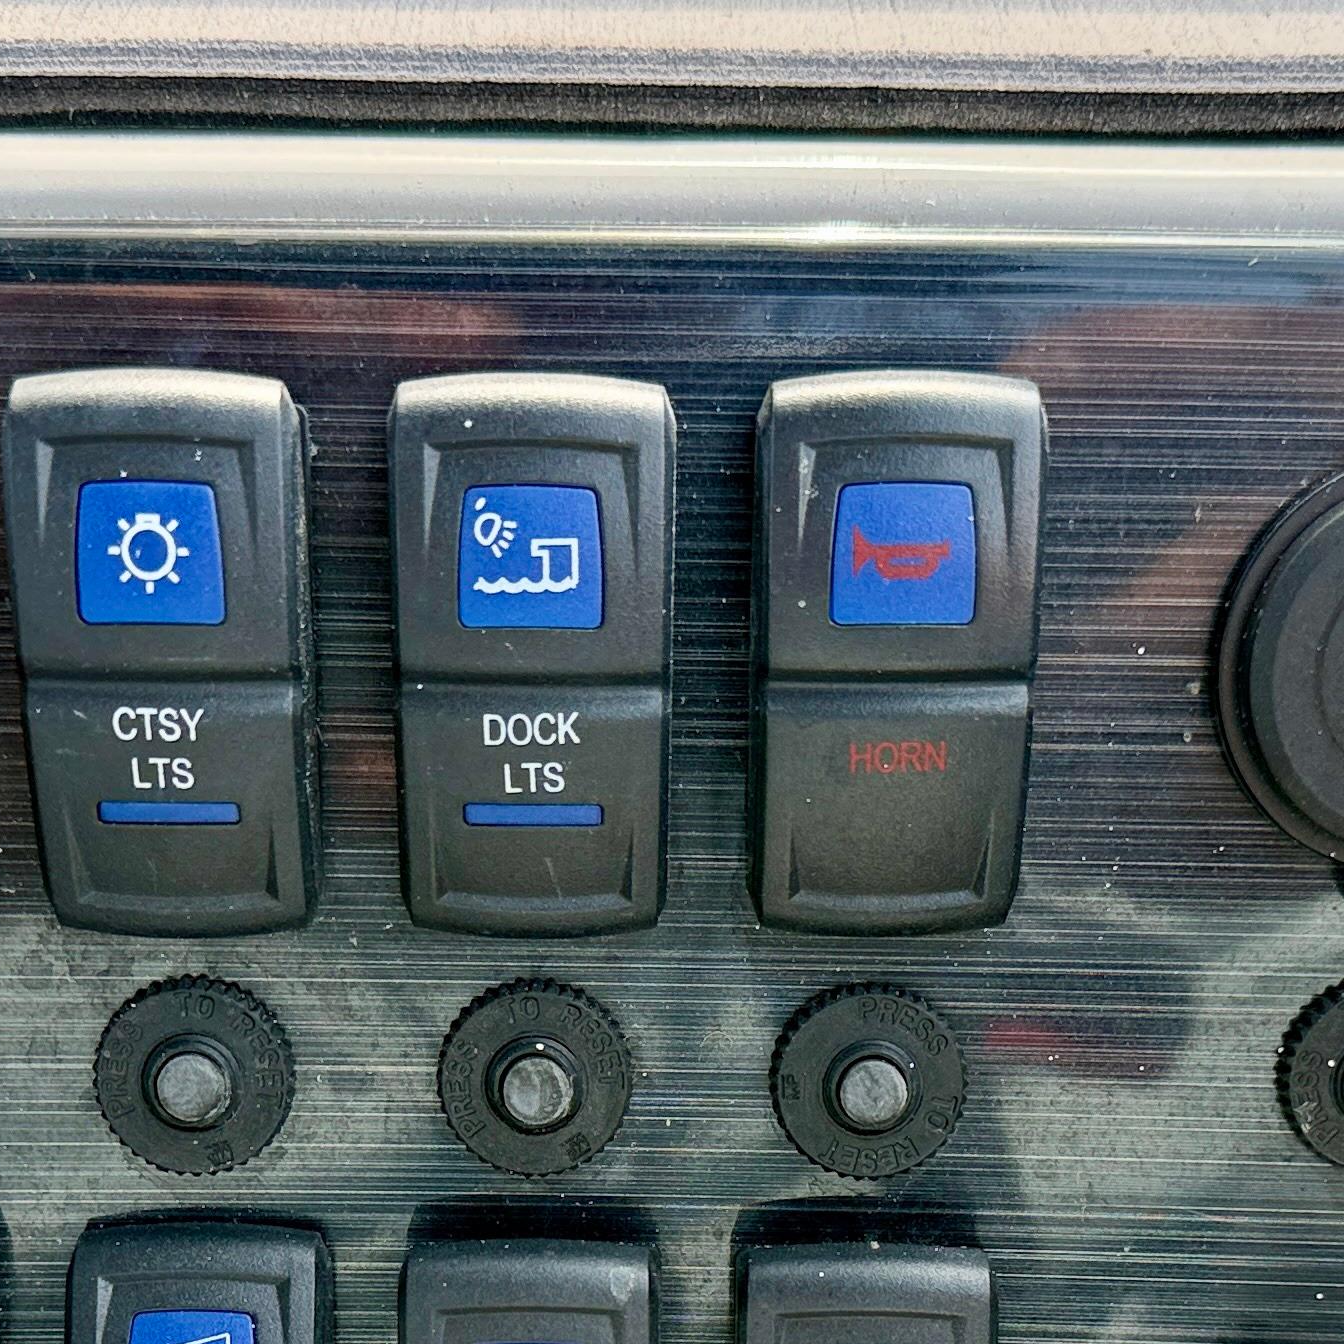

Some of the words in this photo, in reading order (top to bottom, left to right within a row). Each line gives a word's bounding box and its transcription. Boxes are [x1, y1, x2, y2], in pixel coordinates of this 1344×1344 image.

[111, 706, 205, 742] CTSY
[482, 711, 581, 746] DOCK
[131, 756, 195, 790] LTS
[849, 741, 947, 774] HORN
[503, 761, 566, 794] LTS
[858, 996, 948, 1056] PRESS
[106, 1020, 143, 1120] PRESS
[173, 992, 215, 1018] TO
[446, 1040, 487, 1138] PRESS
[504, 996, 540, 1024] TO
[926, 1096, 958, 1131] TO
[818, 1136, 920, 1173] RESET
